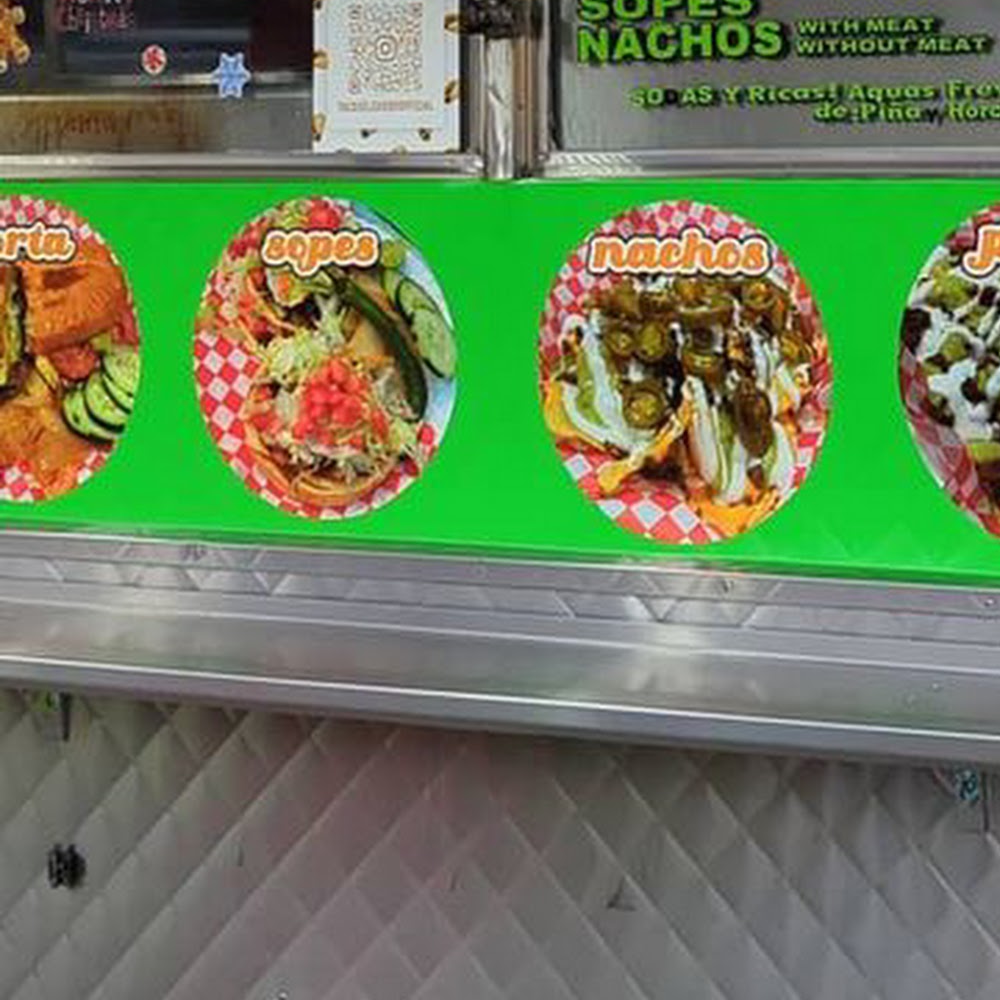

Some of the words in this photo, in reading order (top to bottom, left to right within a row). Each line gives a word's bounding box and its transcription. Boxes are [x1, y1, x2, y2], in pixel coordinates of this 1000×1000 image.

[577, 19, 785, 66] NACHOS
[798, 18, 860, 35] WITH
[865, 16, 937, 33] MEAT
[797, 37, 916, 55] WITHOUT
[917, 36, 988, 53] MEAT
[0, 222, 76, 260] rta
[261, 228, 381, 275] sopes
[589, 229, 773, 275] nachos
